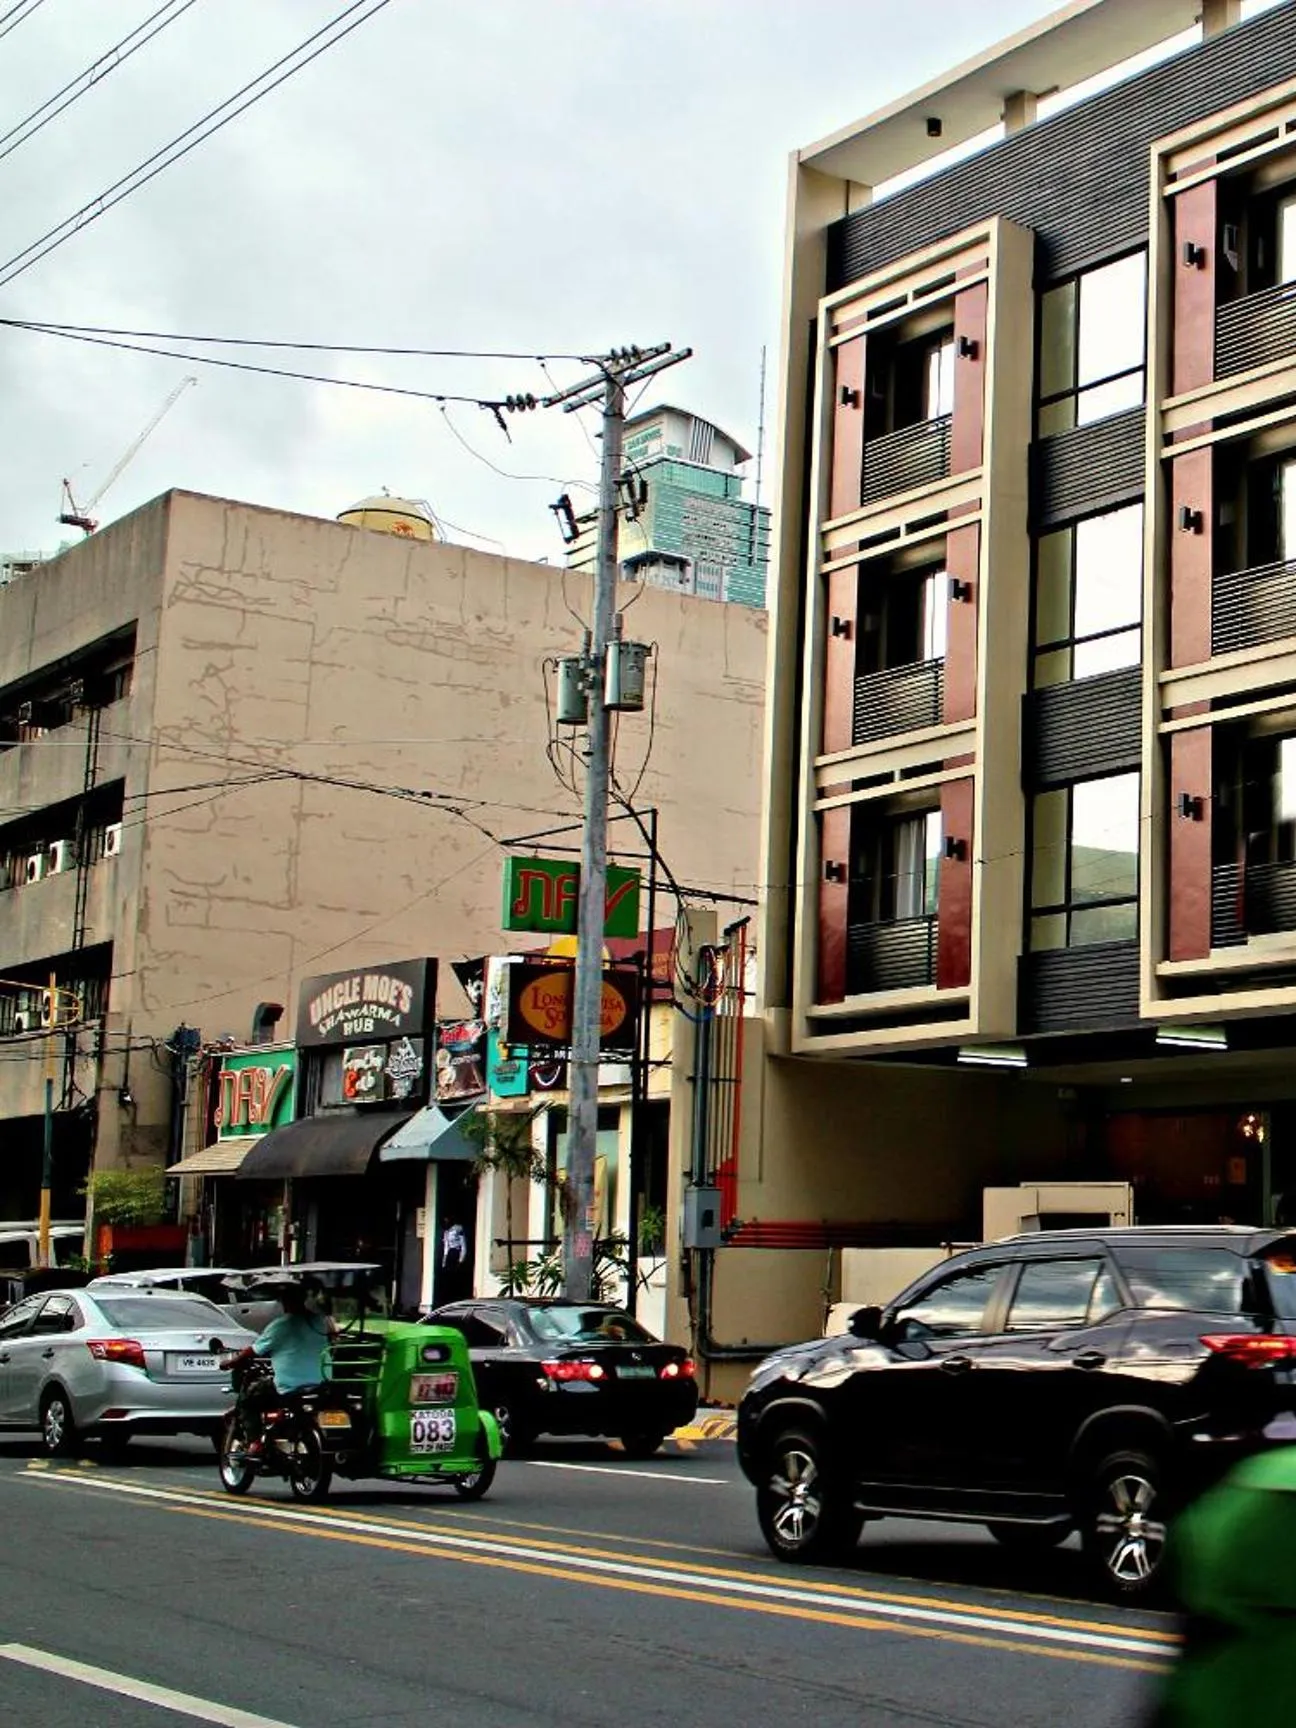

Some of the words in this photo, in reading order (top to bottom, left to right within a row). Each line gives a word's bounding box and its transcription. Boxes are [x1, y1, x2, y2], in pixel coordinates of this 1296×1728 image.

[308, 975, 361, 1026] UNCLE
[362, 974, 413, 1014] MOE'S
[318, 1003, 401, 1038] SHAWARMA
[413, 1420, 454, 1443] 083
